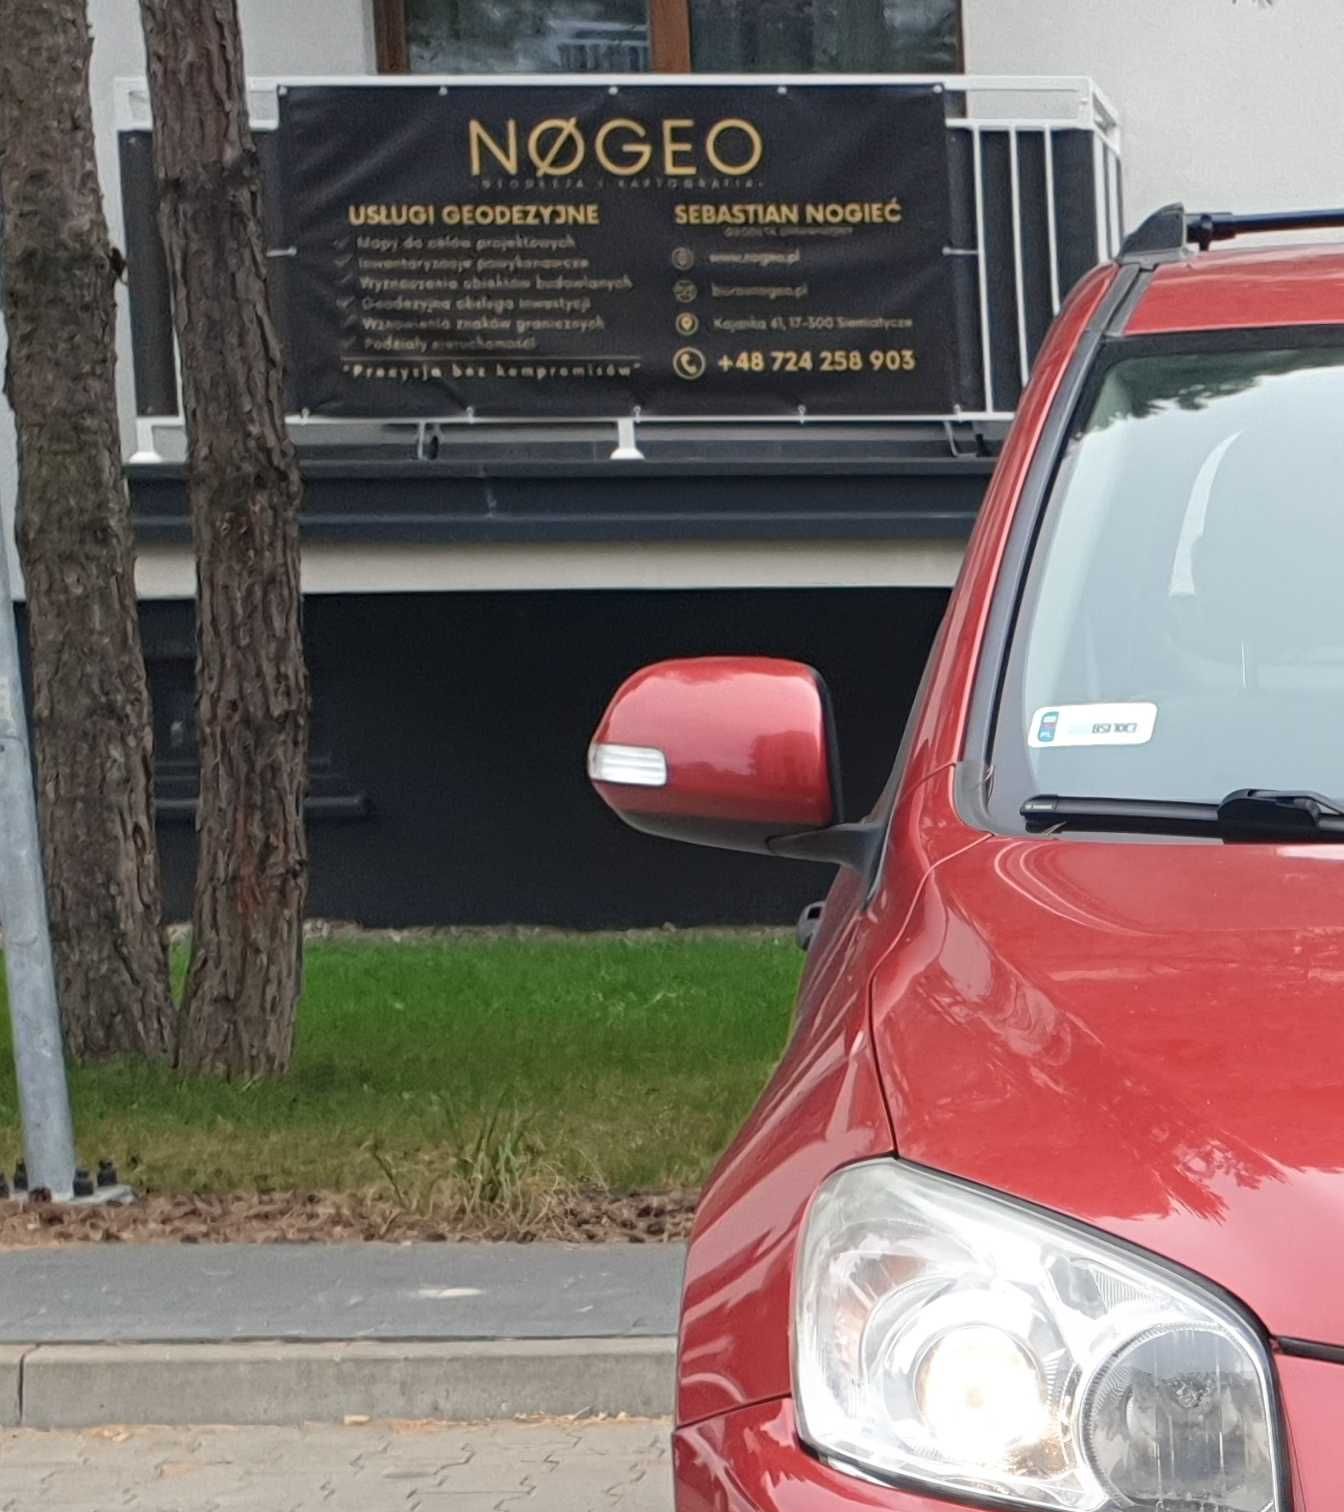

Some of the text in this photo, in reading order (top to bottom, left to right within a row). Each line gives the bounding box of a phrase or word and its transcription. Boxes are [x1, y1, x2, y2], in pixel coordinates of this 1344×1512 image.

[469, 117, 763, 176] NØGEO
[348, 204, 600, 225] USŁUGI GEODEZYJNE
[673, 198, 902, 225] SEBASTIAN NOGIEĆ
[717, 350, 916, 371] +48 724 258 903
